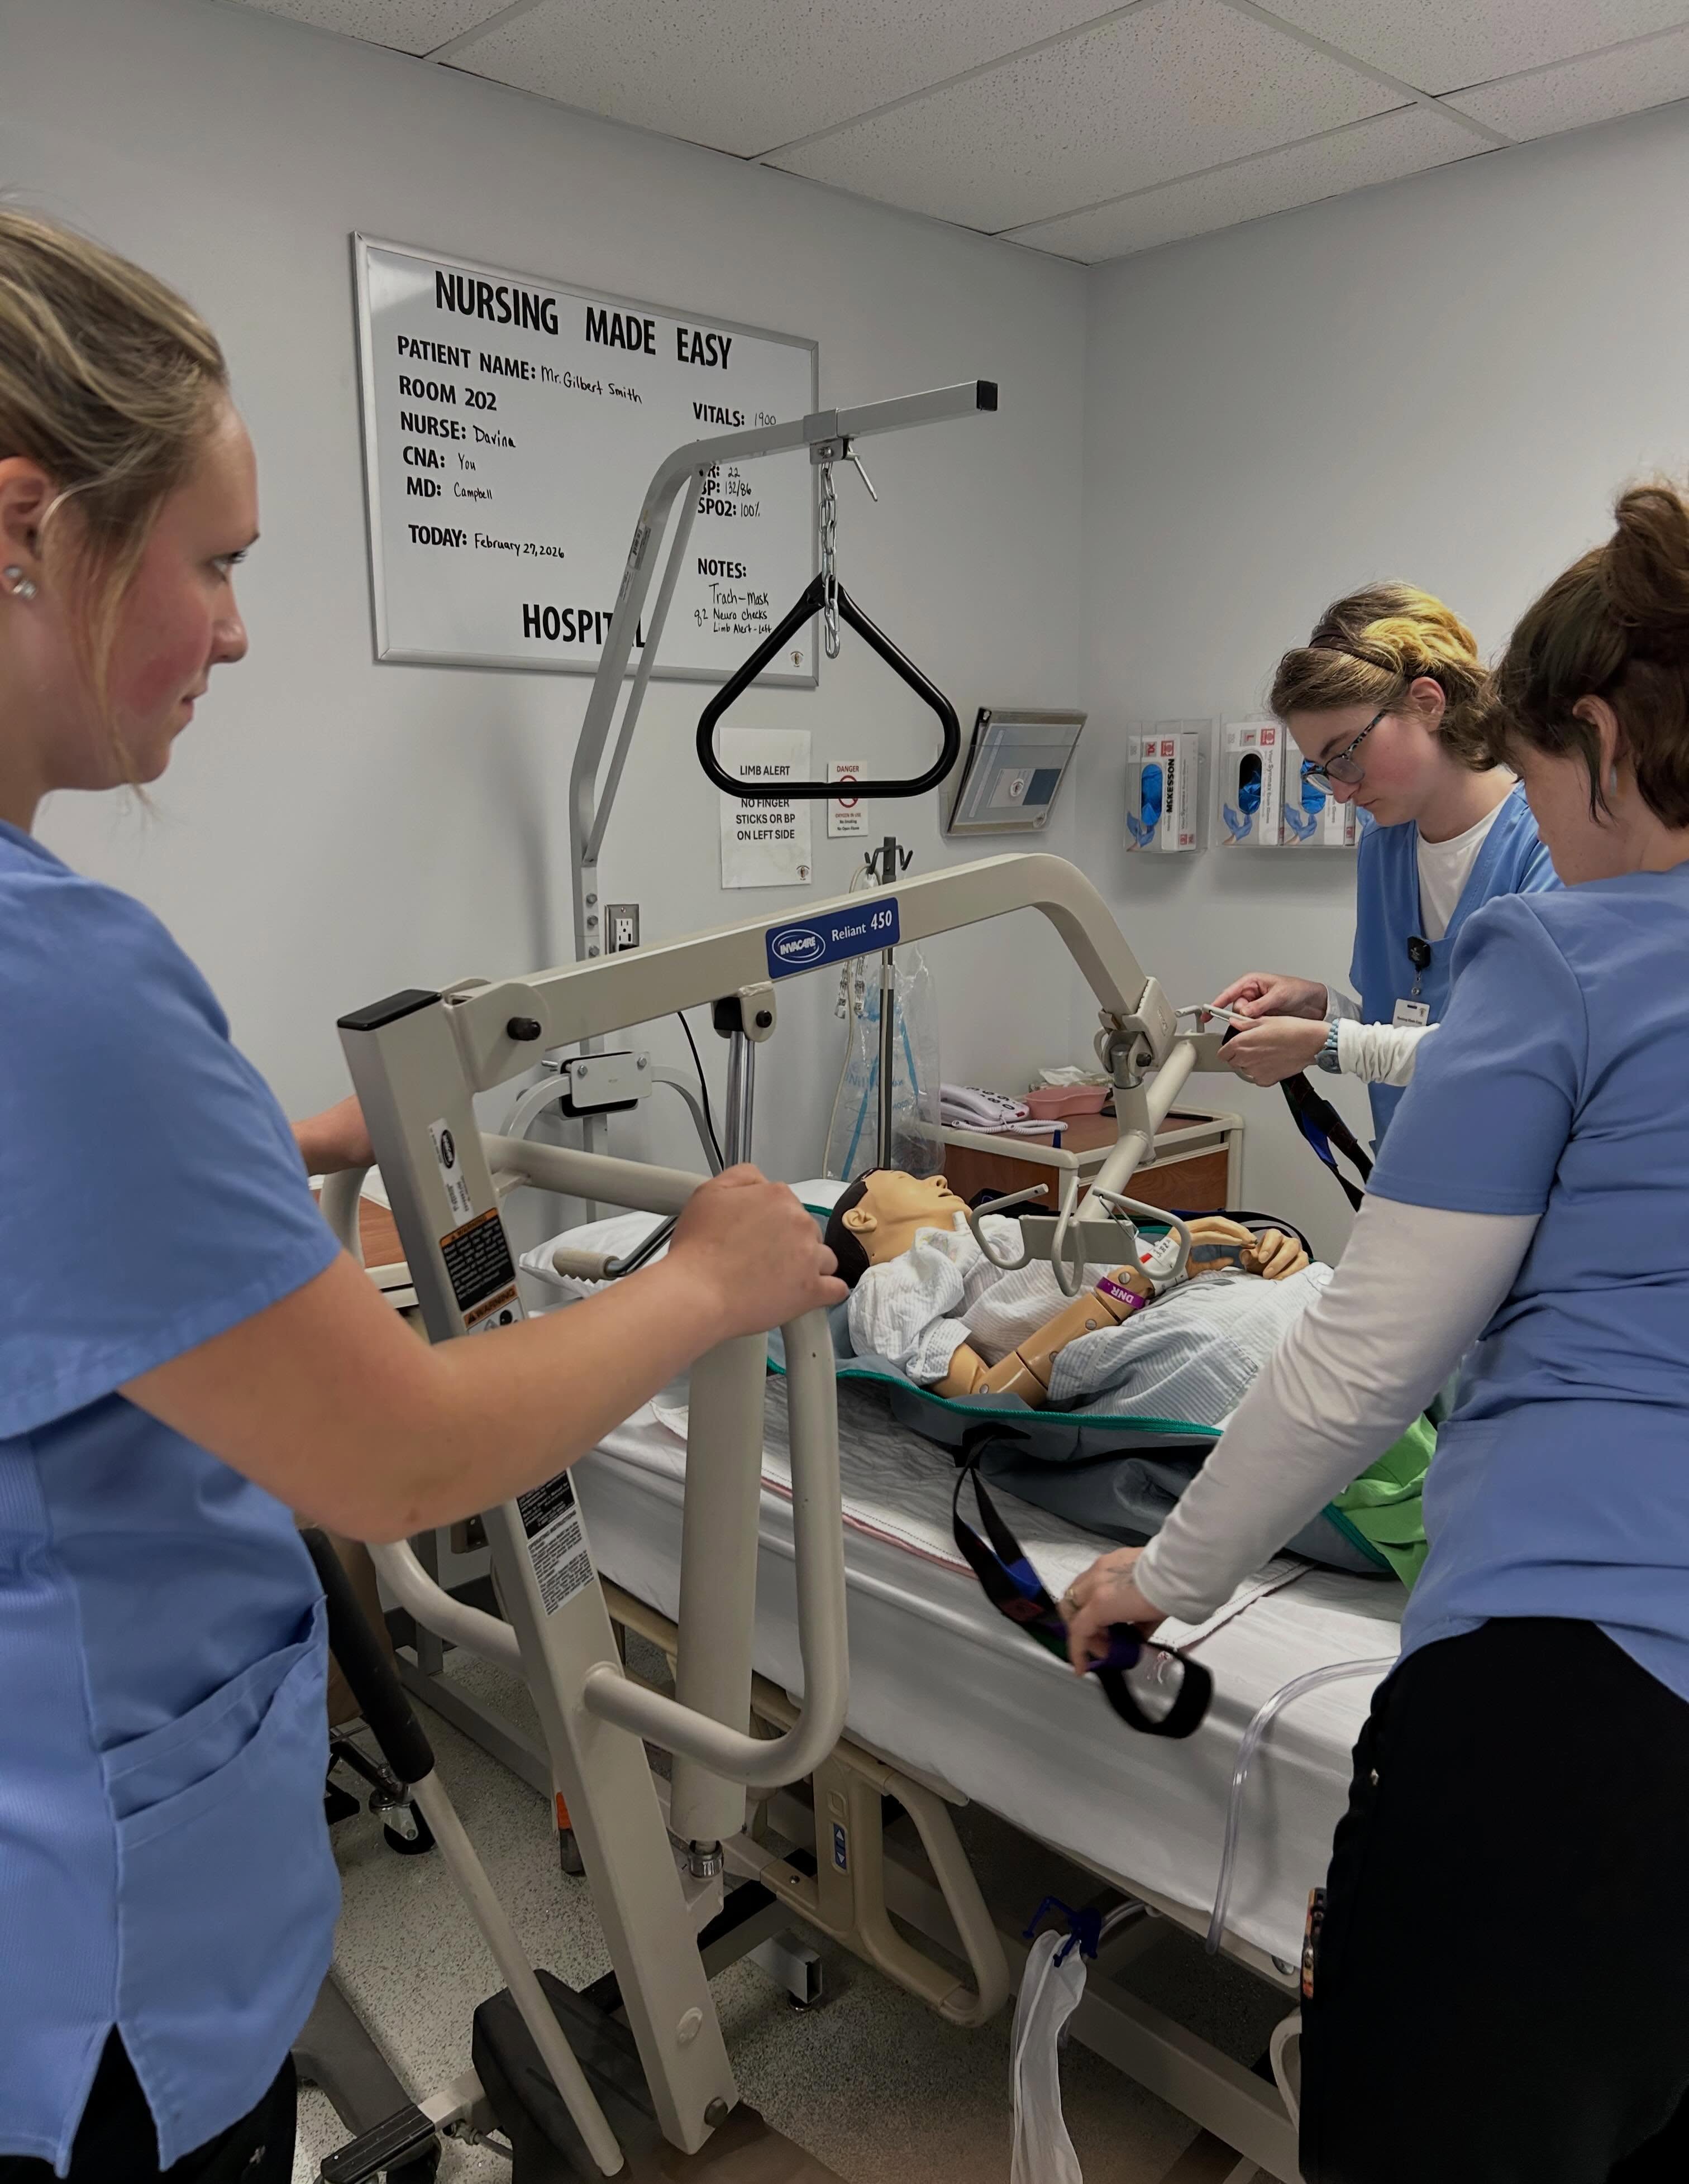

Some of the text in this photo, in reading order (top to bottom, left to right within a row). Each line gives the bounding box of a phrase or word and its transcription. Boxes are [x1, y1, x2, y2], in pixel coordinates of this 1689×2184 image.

[435, 270, 732, 370] NURSING MADE EASY
[398, 335, 536, 380] PATIENT NAME:
[399, 375, 497, 411] ROOM 202
[541, 365, 642, 404] Mr. Gilbert Smith
[693, 402, 745, 427] VITALS:
[755, 412, 776, 426] 1900
[400, 411, 466, 440] NURSE:
[473, 424, 516, 447] Davina
[403, 446, 445, 469] CNA:
[458, 452, 476, 471] You
[728, 467, 740, 477] 22
[407, 476, 441, 498] MD:
[454, 482, 493, 502] Campbell
[726, 480, 752, 497] 132/86
[741, 501, 760, 517] 100%
[408, 524, 467, 547] TODAY:
[474, 533, 565, 558] February 27,2026
[698, 558, 747, 579] NOTES:
[714, 608, 737, 620] Neuro
[523, 604, 646, 648] HOSPIL
[713, 621, 731, 633] Limb
[1148, 742, 1156, 756] XL
[740, 765, 790, 776] LIMB ALERT
[741, 799, 790, 808] NO FINGER
[736, 814, 795, 824] STICKS OR BP
[737, 829, 795, 840] ON LEFT SIDE
[780, 910, 893, 955] INVACARE Reliant 450
[475, 1288, 516, 1317] WARNING
[1110, 1285, 1134, 1304] DNR
